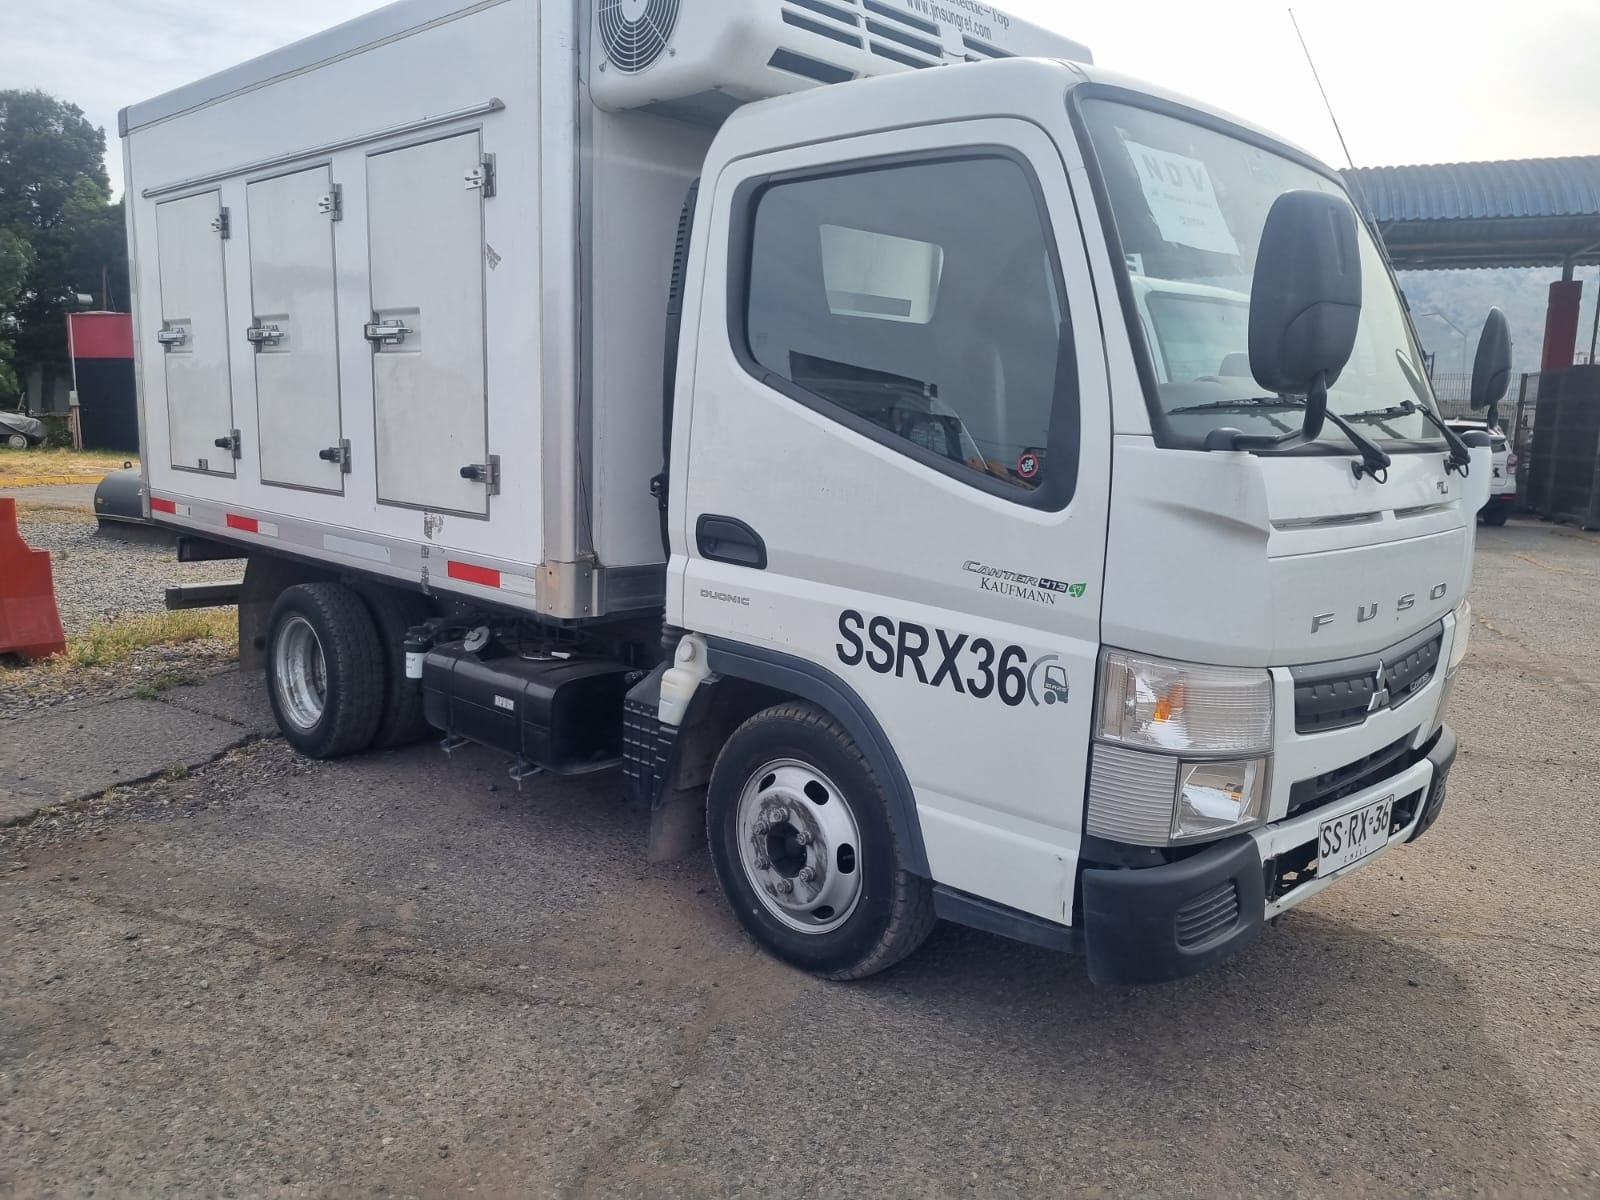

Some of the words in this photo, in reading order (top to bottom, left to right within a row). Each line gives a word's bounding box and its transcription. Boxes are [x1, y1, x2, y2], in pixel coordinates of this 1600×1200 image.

[962, 560, 1039, 586] CANTER
[1040, 578, 1067, 593] 413
[980, 577, 1056, 605] KAUFMANN
[700, 589, 750, 606] DUONIC
[1310, 583, 1447, 634] FUSO
[836, 609, 1028, 706] SSRX36
